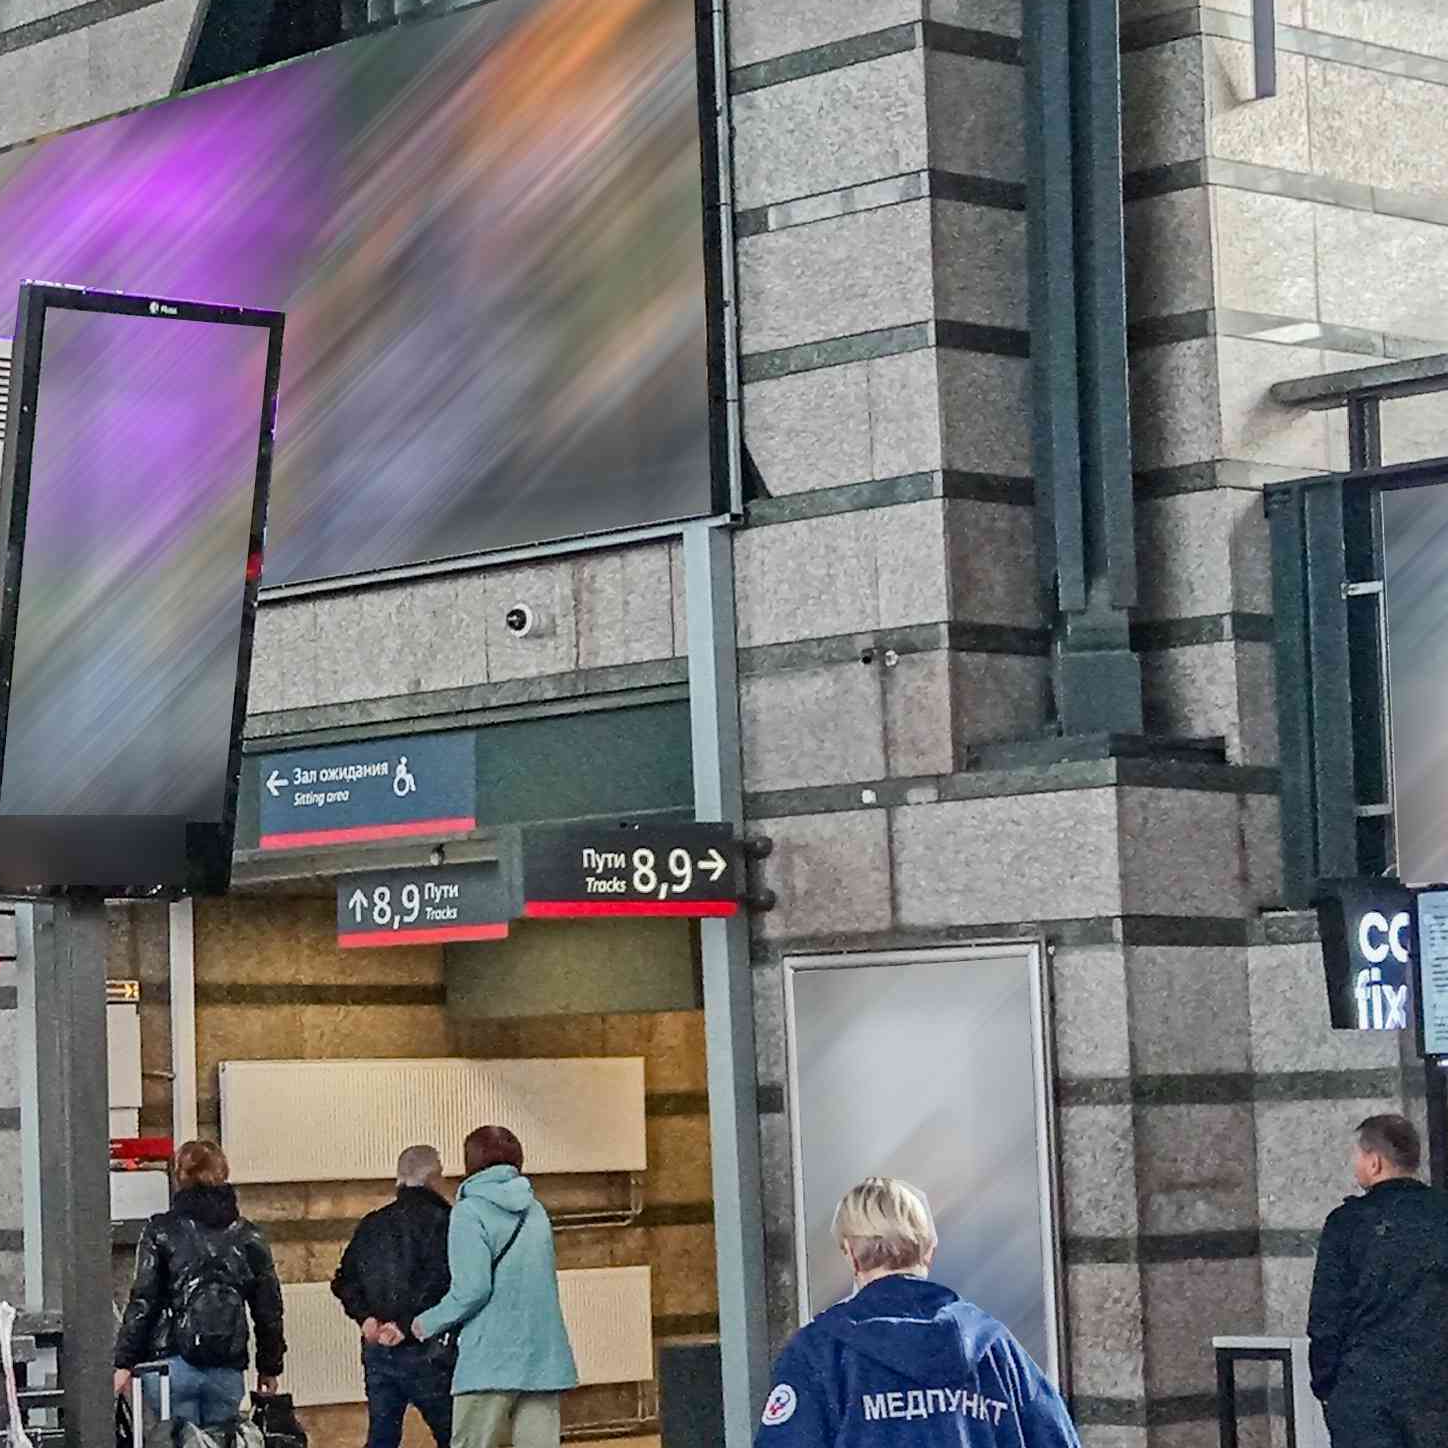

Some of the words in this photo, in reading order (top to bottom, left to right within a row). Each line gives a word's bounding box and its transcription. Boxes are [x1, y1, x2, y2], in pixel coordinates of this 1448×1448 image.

[293, 767, 317, 784] Зал
[319, 761, 389, 783] ожидания
[293, 791, 325, 807] Sitting
[582, 848, 627, 873] Пути
[632, 848, 694, 900] 8,9
[586, 877, 627, 894] Tracks
[372, 883, 421, 930] 8,9
[424, 881, 460, 904] Пути
[425, 905, 458, 921] Tracks
[1355, 967, 1408, 1030] fix
[862, 1387, 1008, 1427] МЕДПУНКТ
